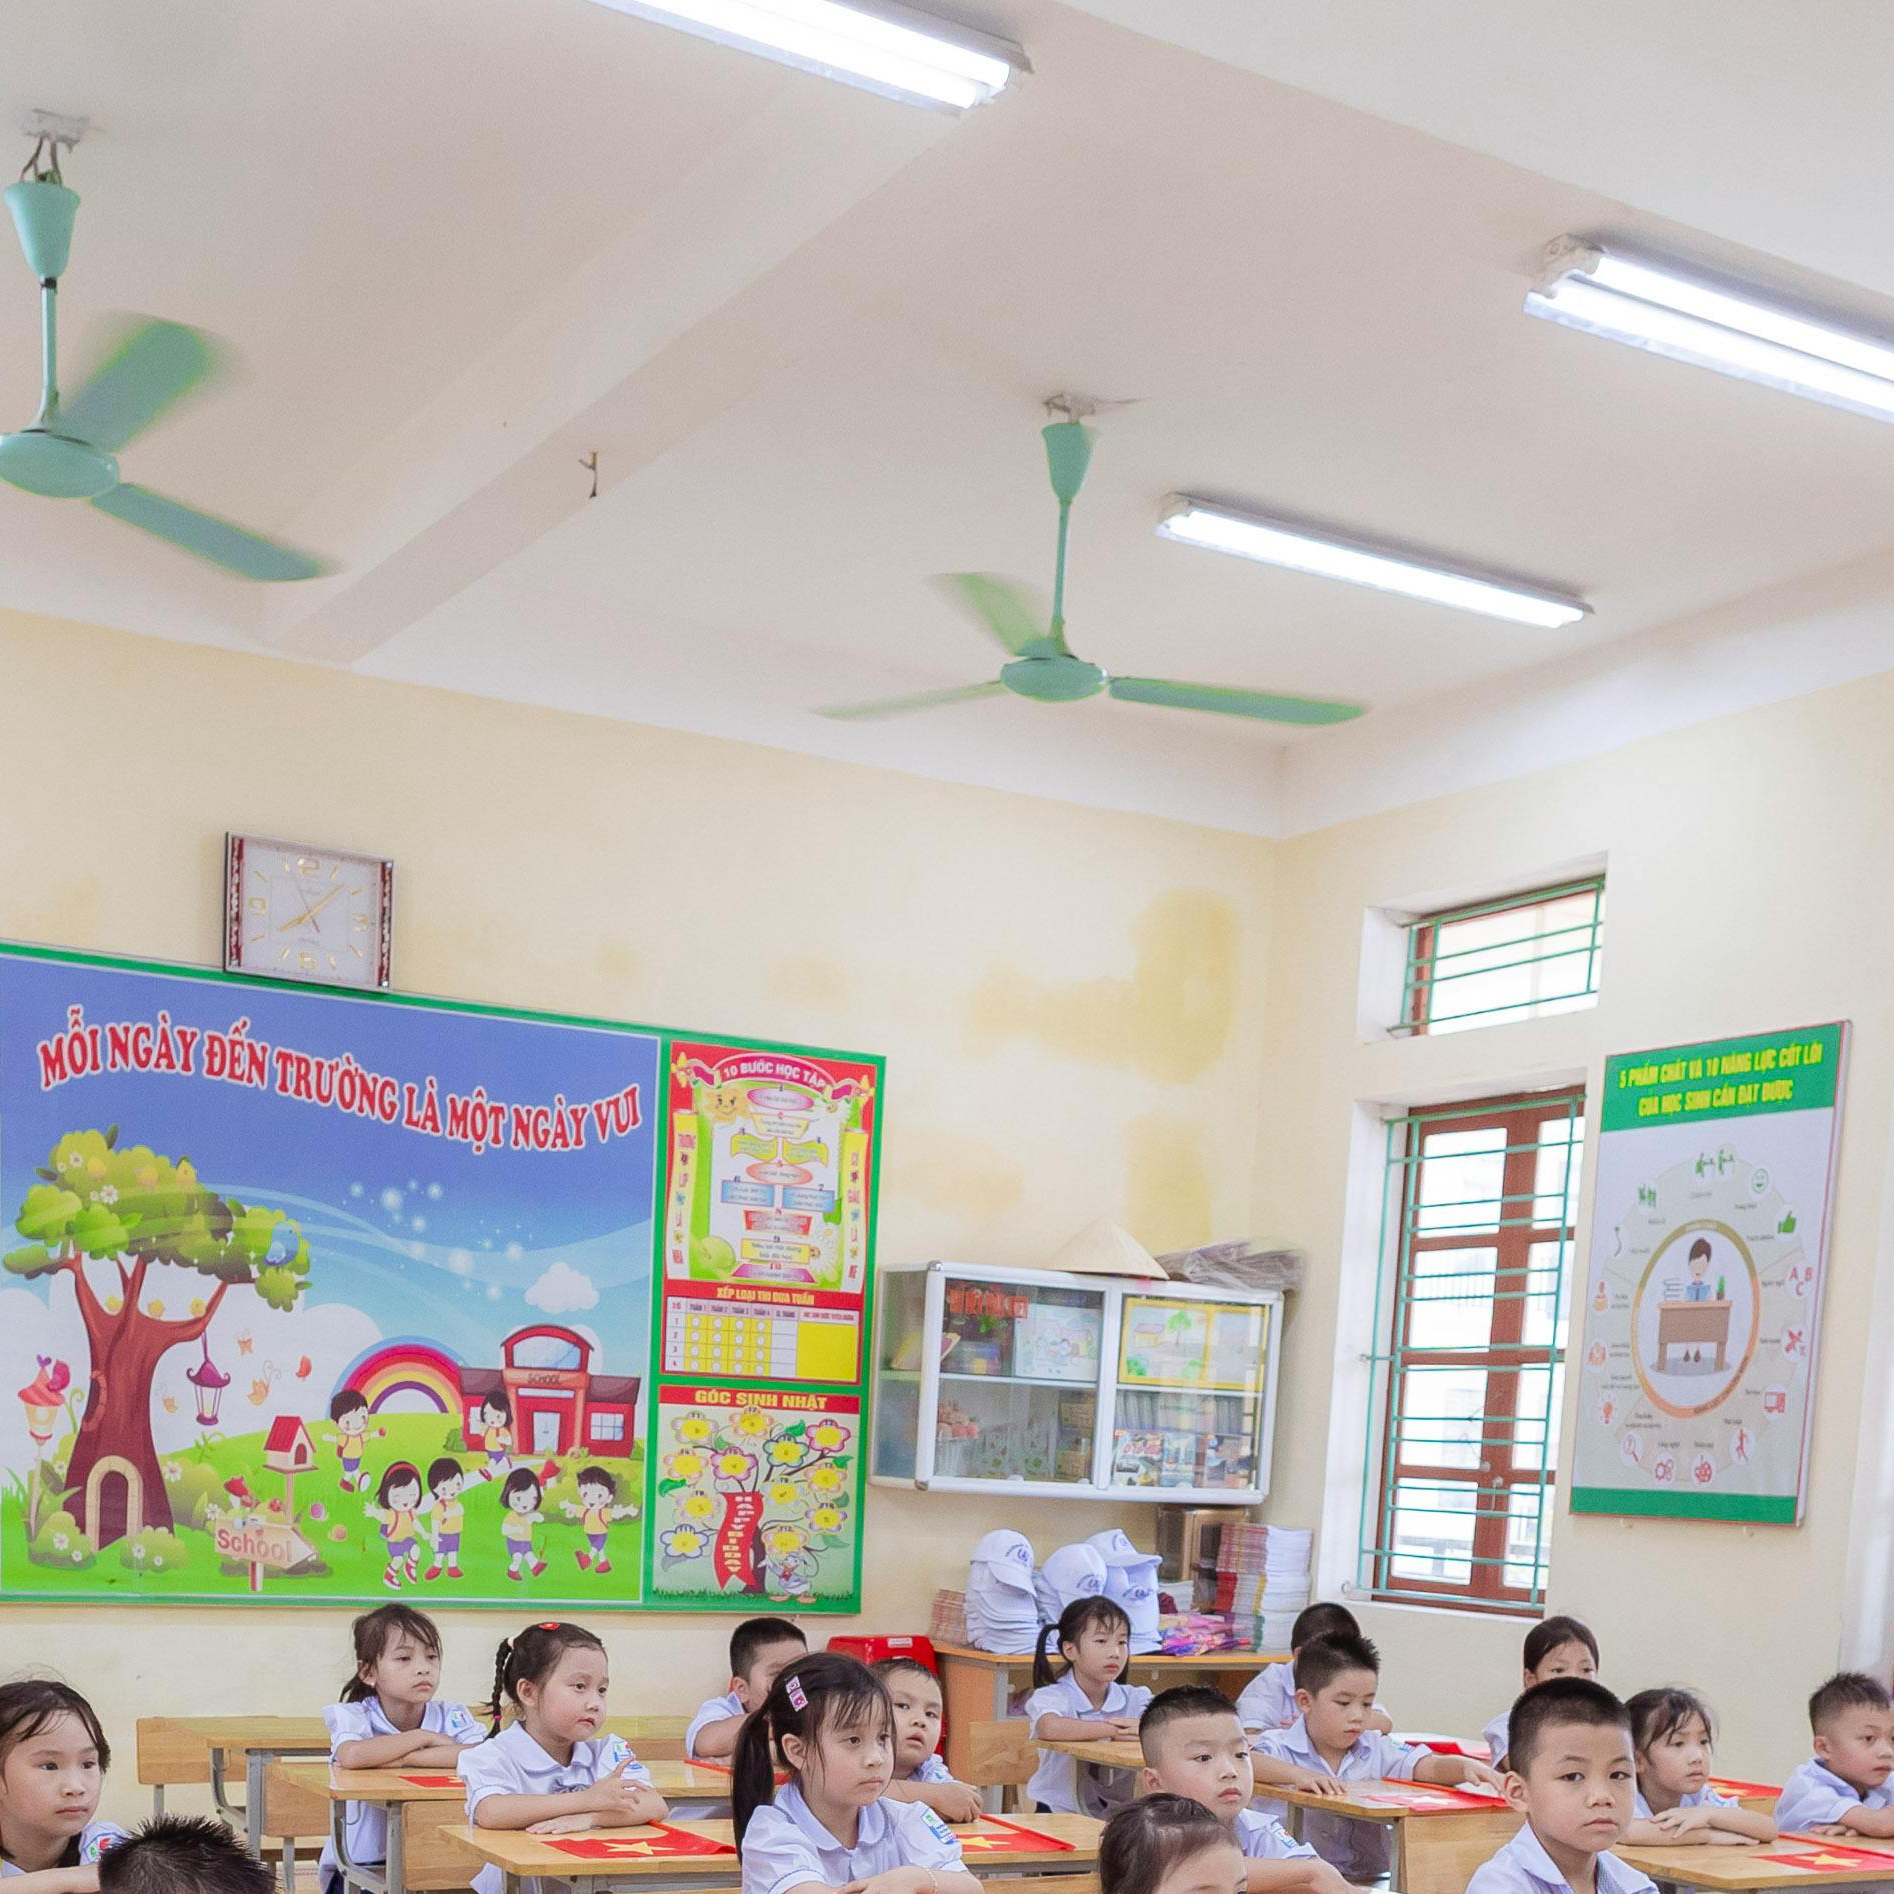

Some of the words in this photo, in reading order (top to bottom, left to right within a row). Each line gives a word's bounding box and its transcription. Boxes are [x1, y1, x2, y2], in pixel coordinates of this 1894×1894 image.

[39, 1007, 101, 1089] MỖI
[108, 1013, 198, 1072] NGÀY
[205, 1018, 268, 1087] ĐẾN
[275, 1051, 397, 1122] TRƯỜNG
[405, 1076, 441, 1133] LÀ
[449, 1087, 507, 1153] MỘT
[513, 1093, 588, 1149] NGÀY
[595, 1086, 640, 1142] VUI
[724, 1064, 737, 1078] 10
[740, 1058, 774, 1075] BƯỚC
[776, 1062, 800, 1079] HỌC
[804, 1071, 827, 1090] TẬP
[1789, 1266, 1798, 1280] A
[695, 1388, 731, 1404] GÓC
[736, 1392, 778, 1407] SINH
[782, 1394, 828, 1411] NHẬT
[217, 1528, 292, 1562] School
